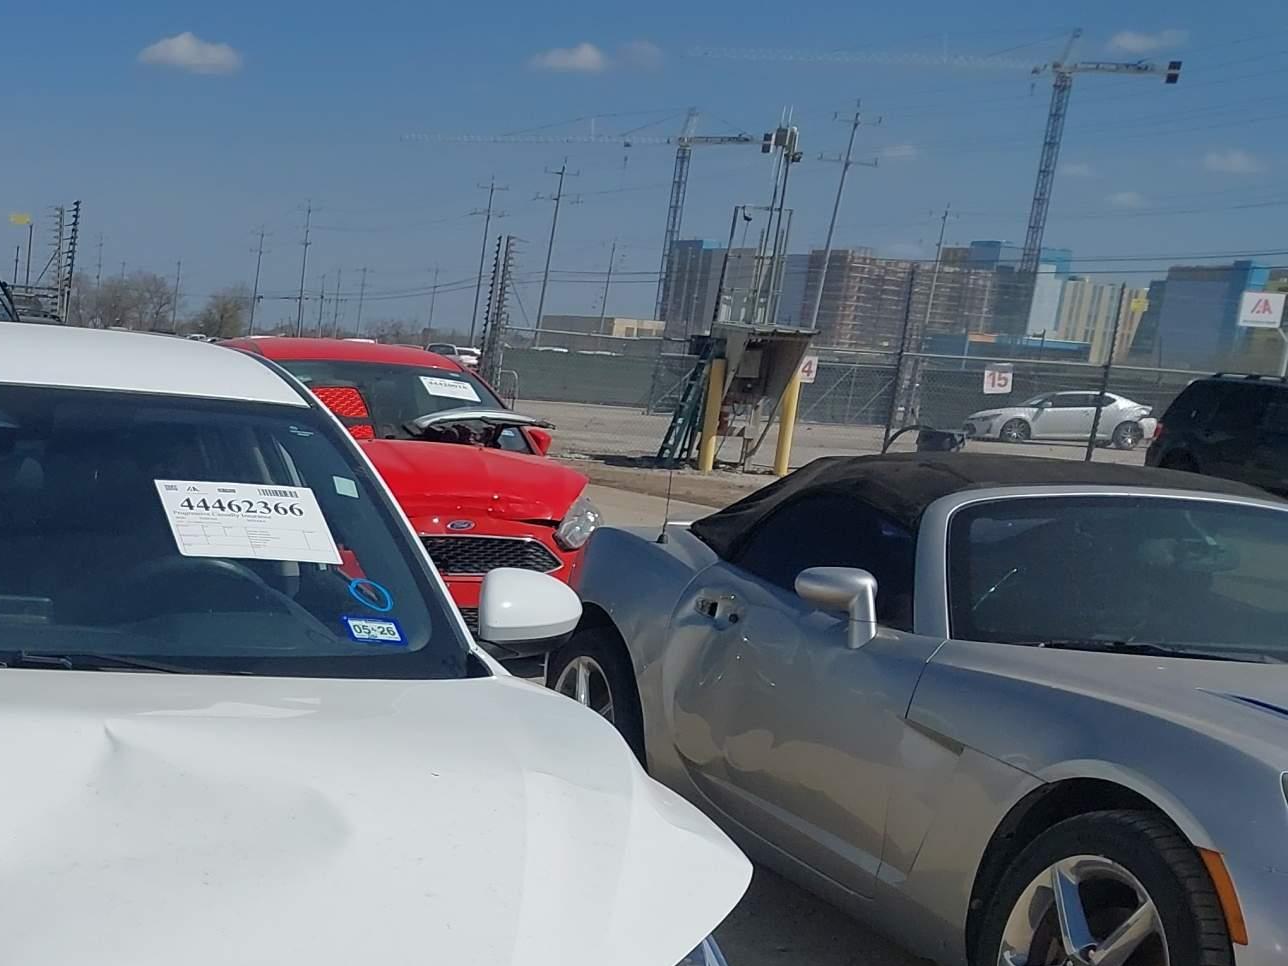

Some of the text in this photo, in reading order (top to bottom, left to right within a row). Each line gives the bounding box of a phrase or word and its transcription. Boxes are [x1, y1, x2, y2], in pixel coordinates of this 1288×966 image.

[988, 371, 1009, 388] 15
[180, 497, 304, 517] 44462366
[353, 624, 396, 636] 05 26
